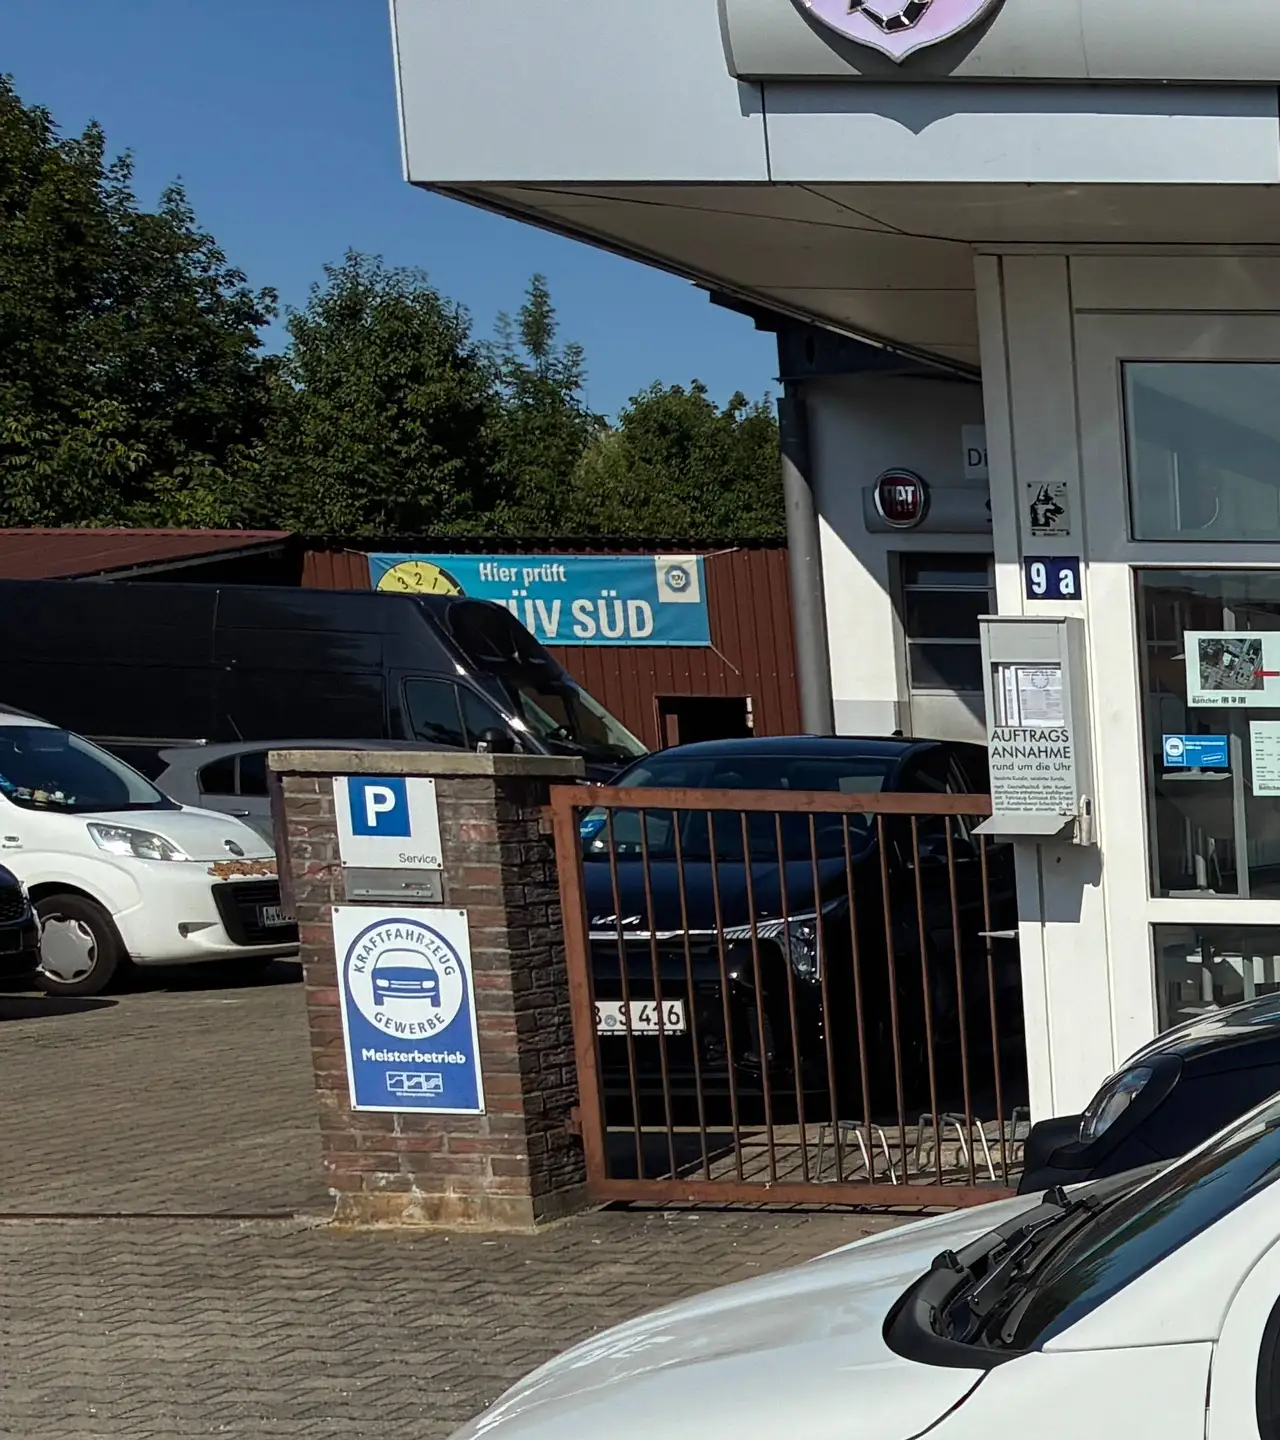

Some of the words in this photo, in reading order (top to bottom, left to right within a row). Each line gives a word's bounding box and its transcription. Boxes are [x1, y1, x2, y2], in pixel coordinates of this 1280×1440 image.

[397, 576, 409, 591] 3
[415, 572, 424, 587] 2
[479, 563, 516, 582] Hier
[523, 562, 567, 587] prüft
[1031, 562, 1047, 594] 9
[1059, 569, 1075, 595] a
[490, 589, 561, 637] ÜV
[571, 589, 654, 638] SÜD
[991, 729, 1069, 743] AUFTRAGS
[991, 746, 1071, 759] ANNAHME
[992, 762, 1014, 771] rund
[1018, 763, 1032, 771] um
[1036, 762, 1050, 771] die
[1054, 762, 1071, 771] Uhr
[364, 785, 396, 827] P
[398, 853, 437, 864] Service
[353, 928, 456, 976] KRAFTFAHRZEUG
[374, 1011, 445, 1035] GEWERBE
[362, 1048, 467, 1064] Meisterbetrieb
